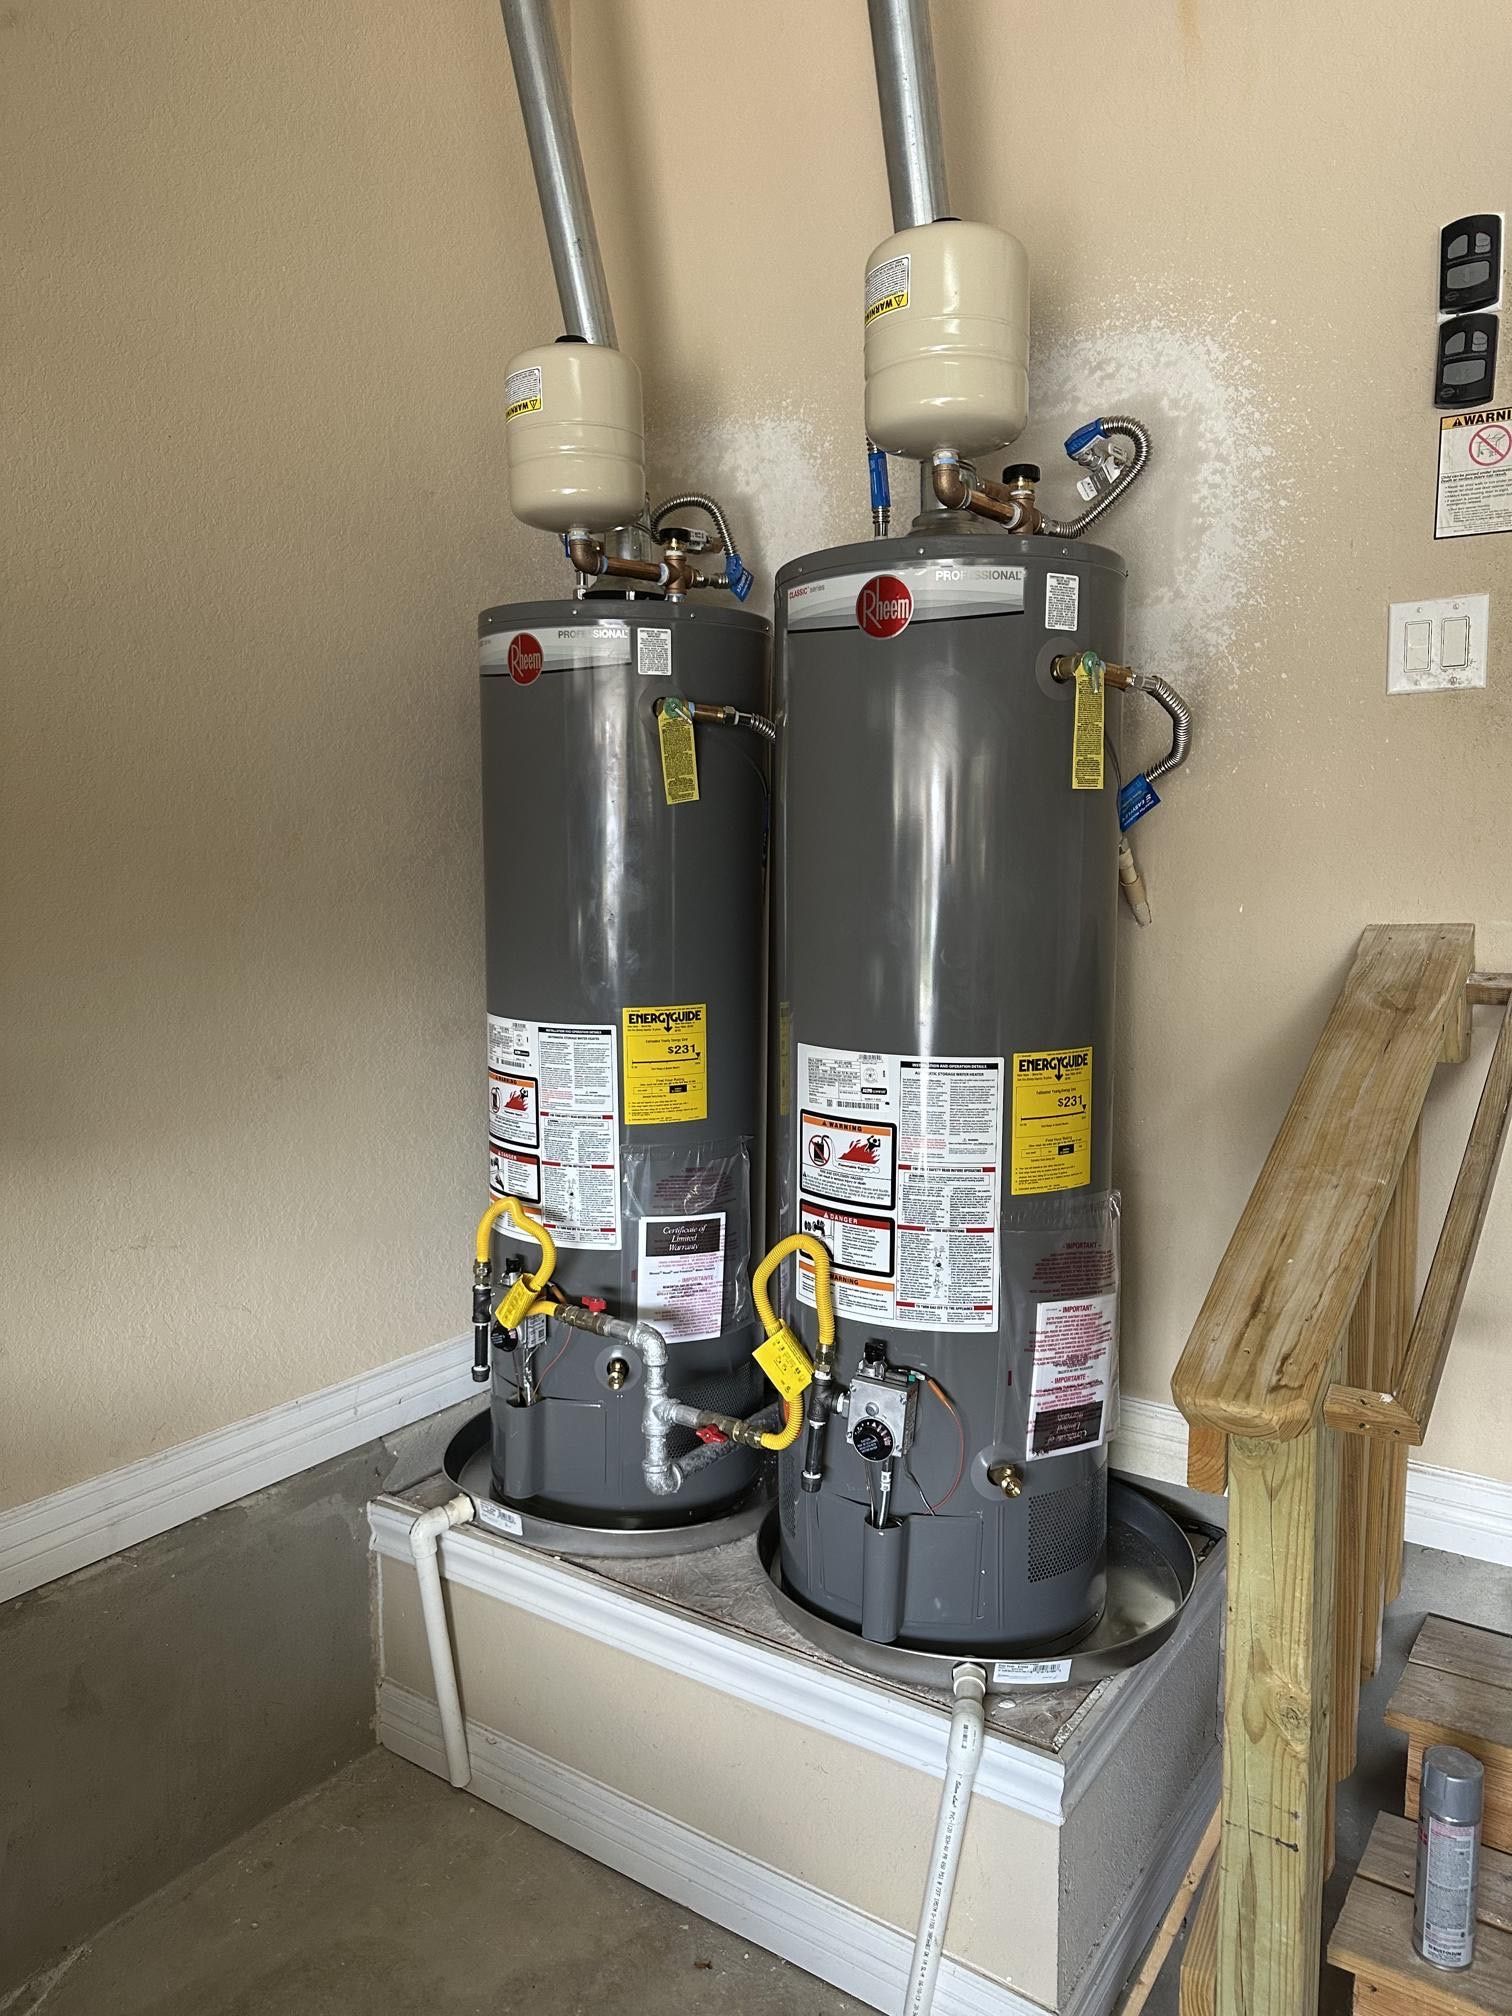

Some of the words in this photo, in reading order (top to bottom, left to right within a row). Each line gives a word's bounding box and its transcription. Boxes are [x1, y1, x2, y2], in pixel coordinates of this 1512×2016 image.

[863, 578, 909, 629] Rheem
[511, 635, 540, 677] Rheem
[628, 1010, 702, 1024] ENERGYGUIDE
[1019, 1053, 1088, 1072] ENERGYGUIDE
[830, 1120, 862, 1132] WARNING
[830, 1213, 858, 1224] DANGER
[1062, 1304, 1093, 1313] IMPORTANT
[1054, 1374, 1086, 1384] IMPORTANTE
